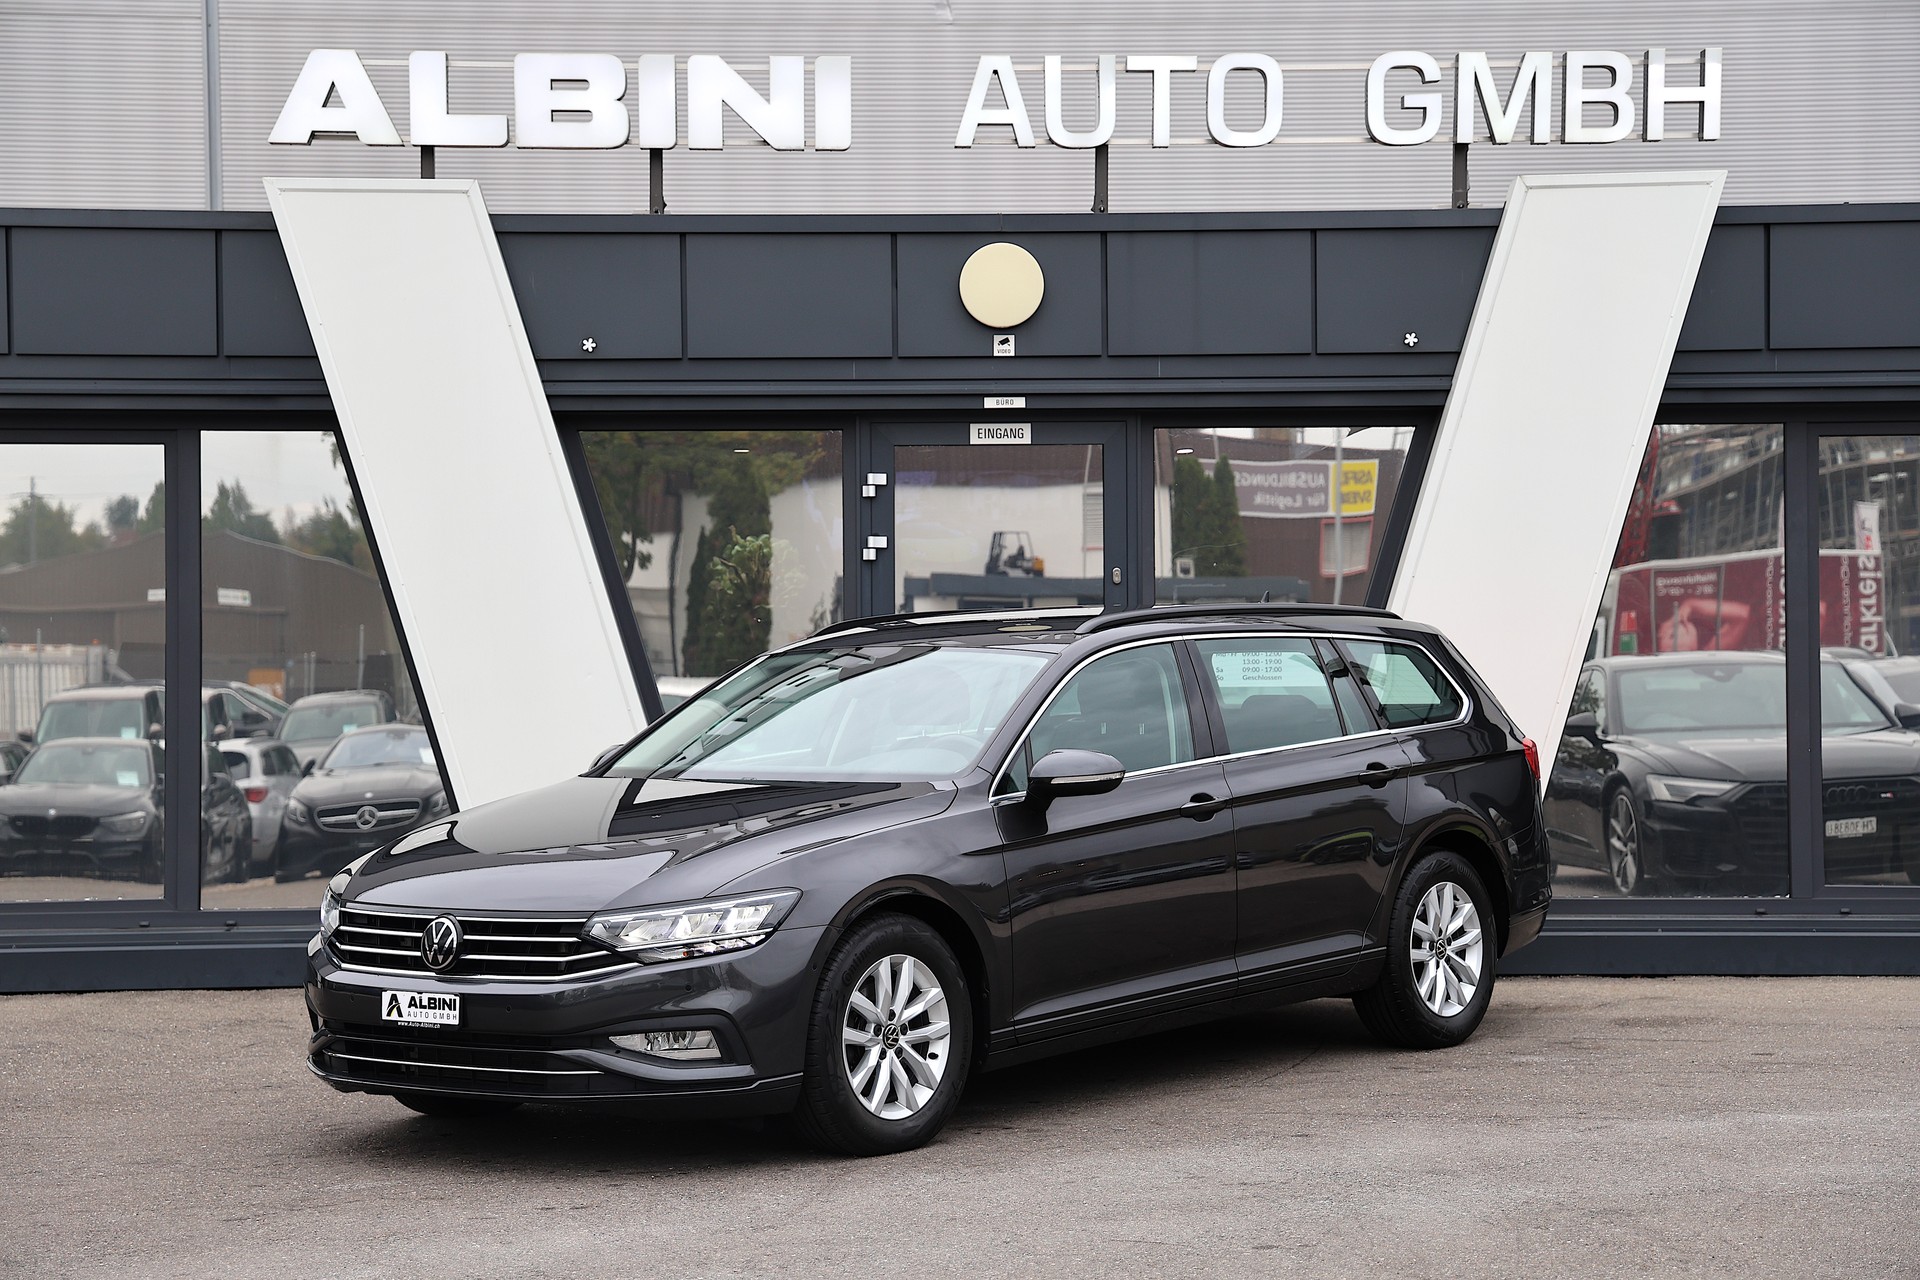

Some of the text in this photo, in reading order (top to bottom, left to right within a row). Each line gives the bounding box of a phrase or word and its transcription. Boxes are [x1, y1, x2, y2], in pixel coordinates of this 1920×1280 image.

[268, 48, 1723, 151] ALBINI AUTO GMBH
[977, 428, 1024, 439] EINGANG
[408, 996, 457, 1011] ALBINI
[408, 1011, 457, 1020] AUTO GMBH
